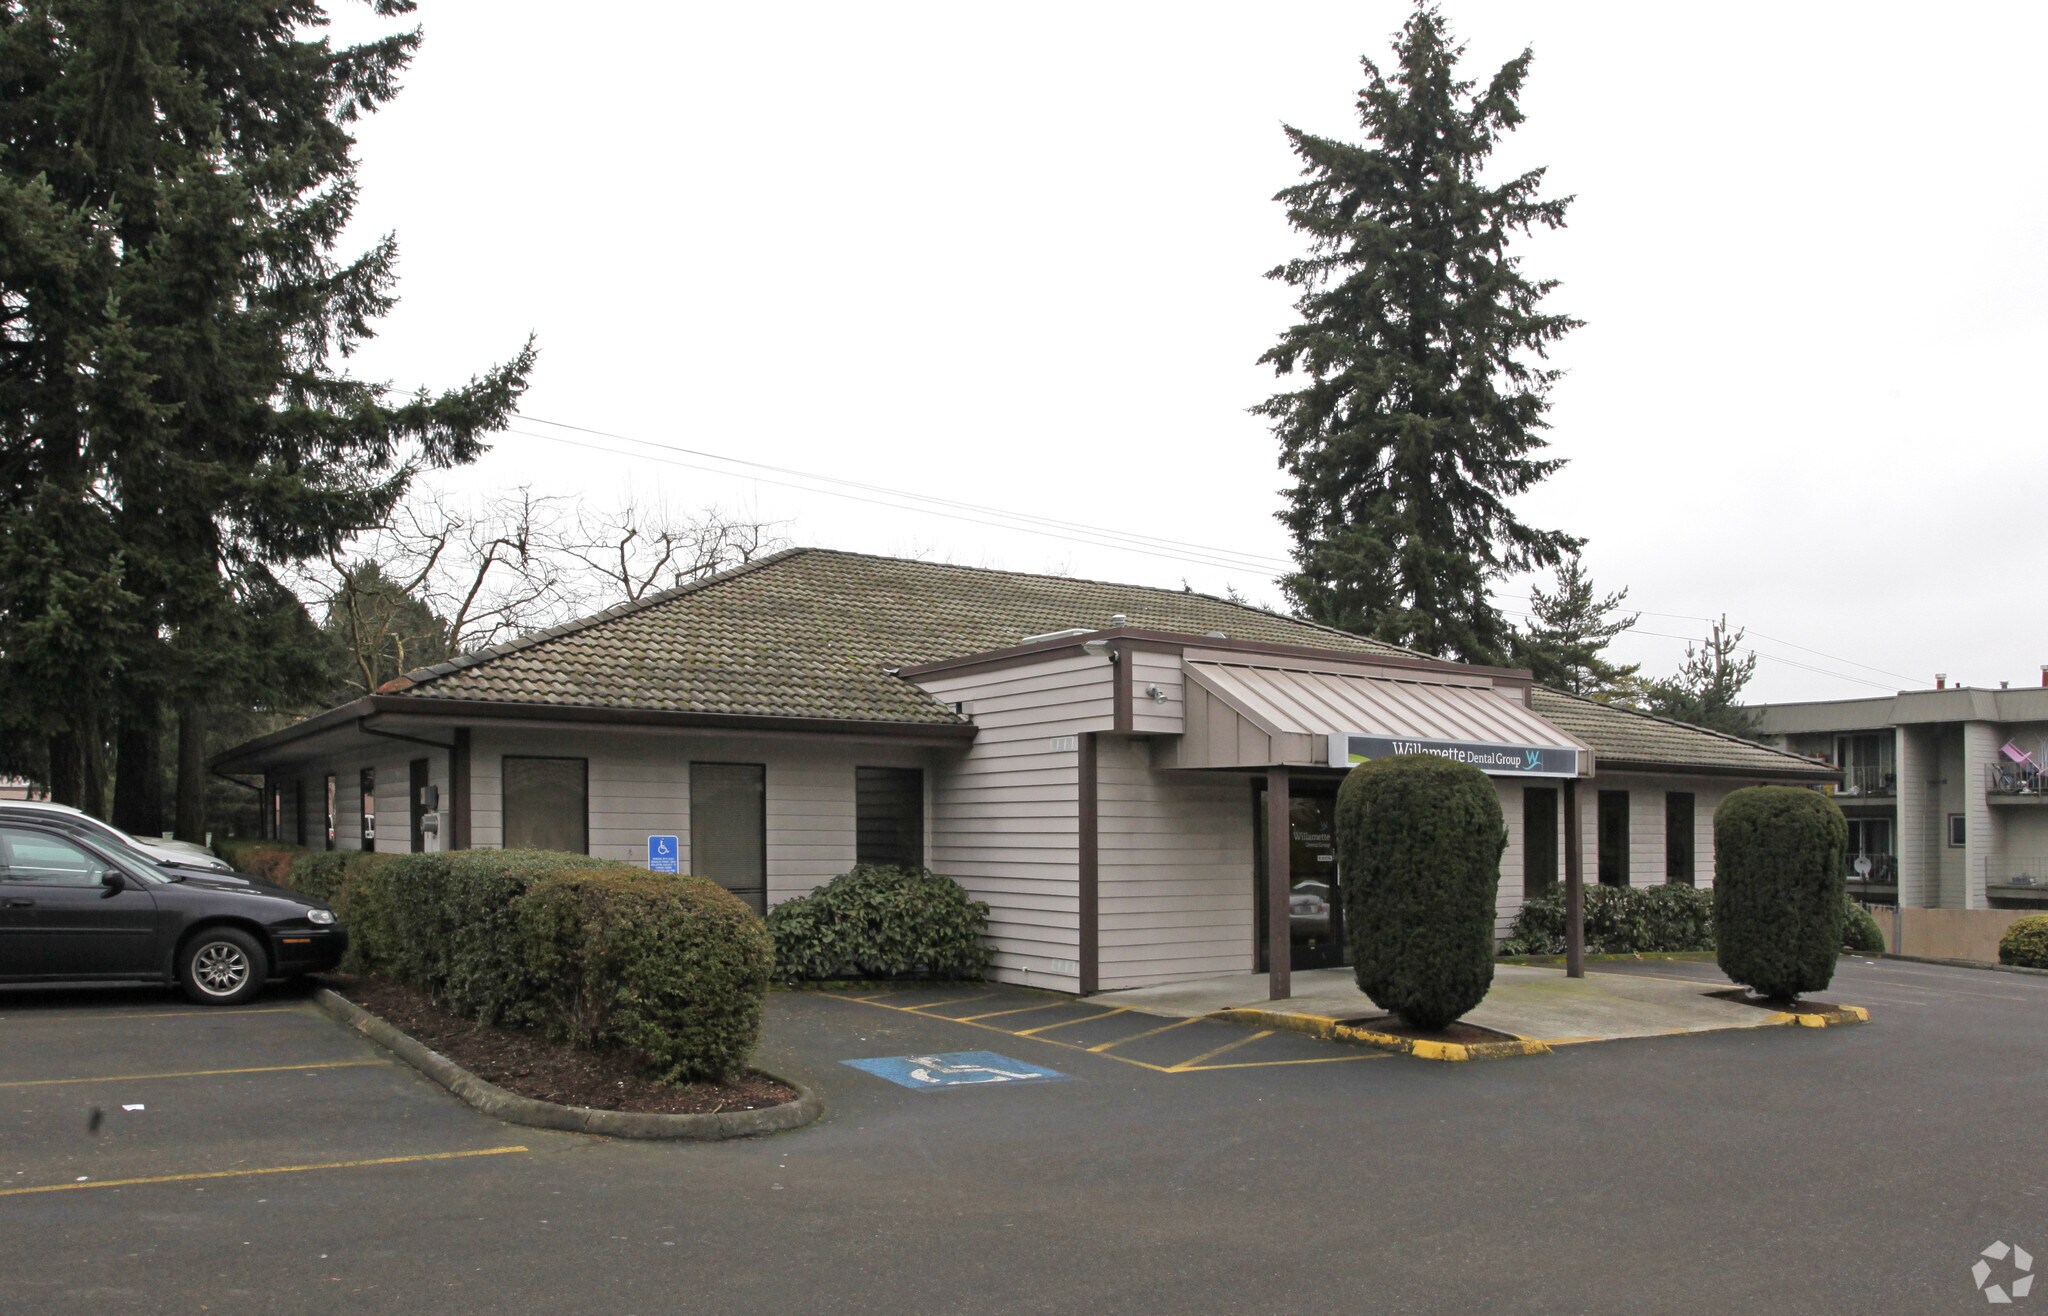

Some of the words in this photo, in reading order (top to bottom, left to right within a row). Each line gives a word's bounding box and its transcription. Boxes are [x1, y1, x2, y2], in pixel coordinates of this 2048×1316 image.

[1467, 751, 1495, 764] Dental
[1496, 753, 1521, 768] Group
[1293, 832, 1330, 841] Willamette
